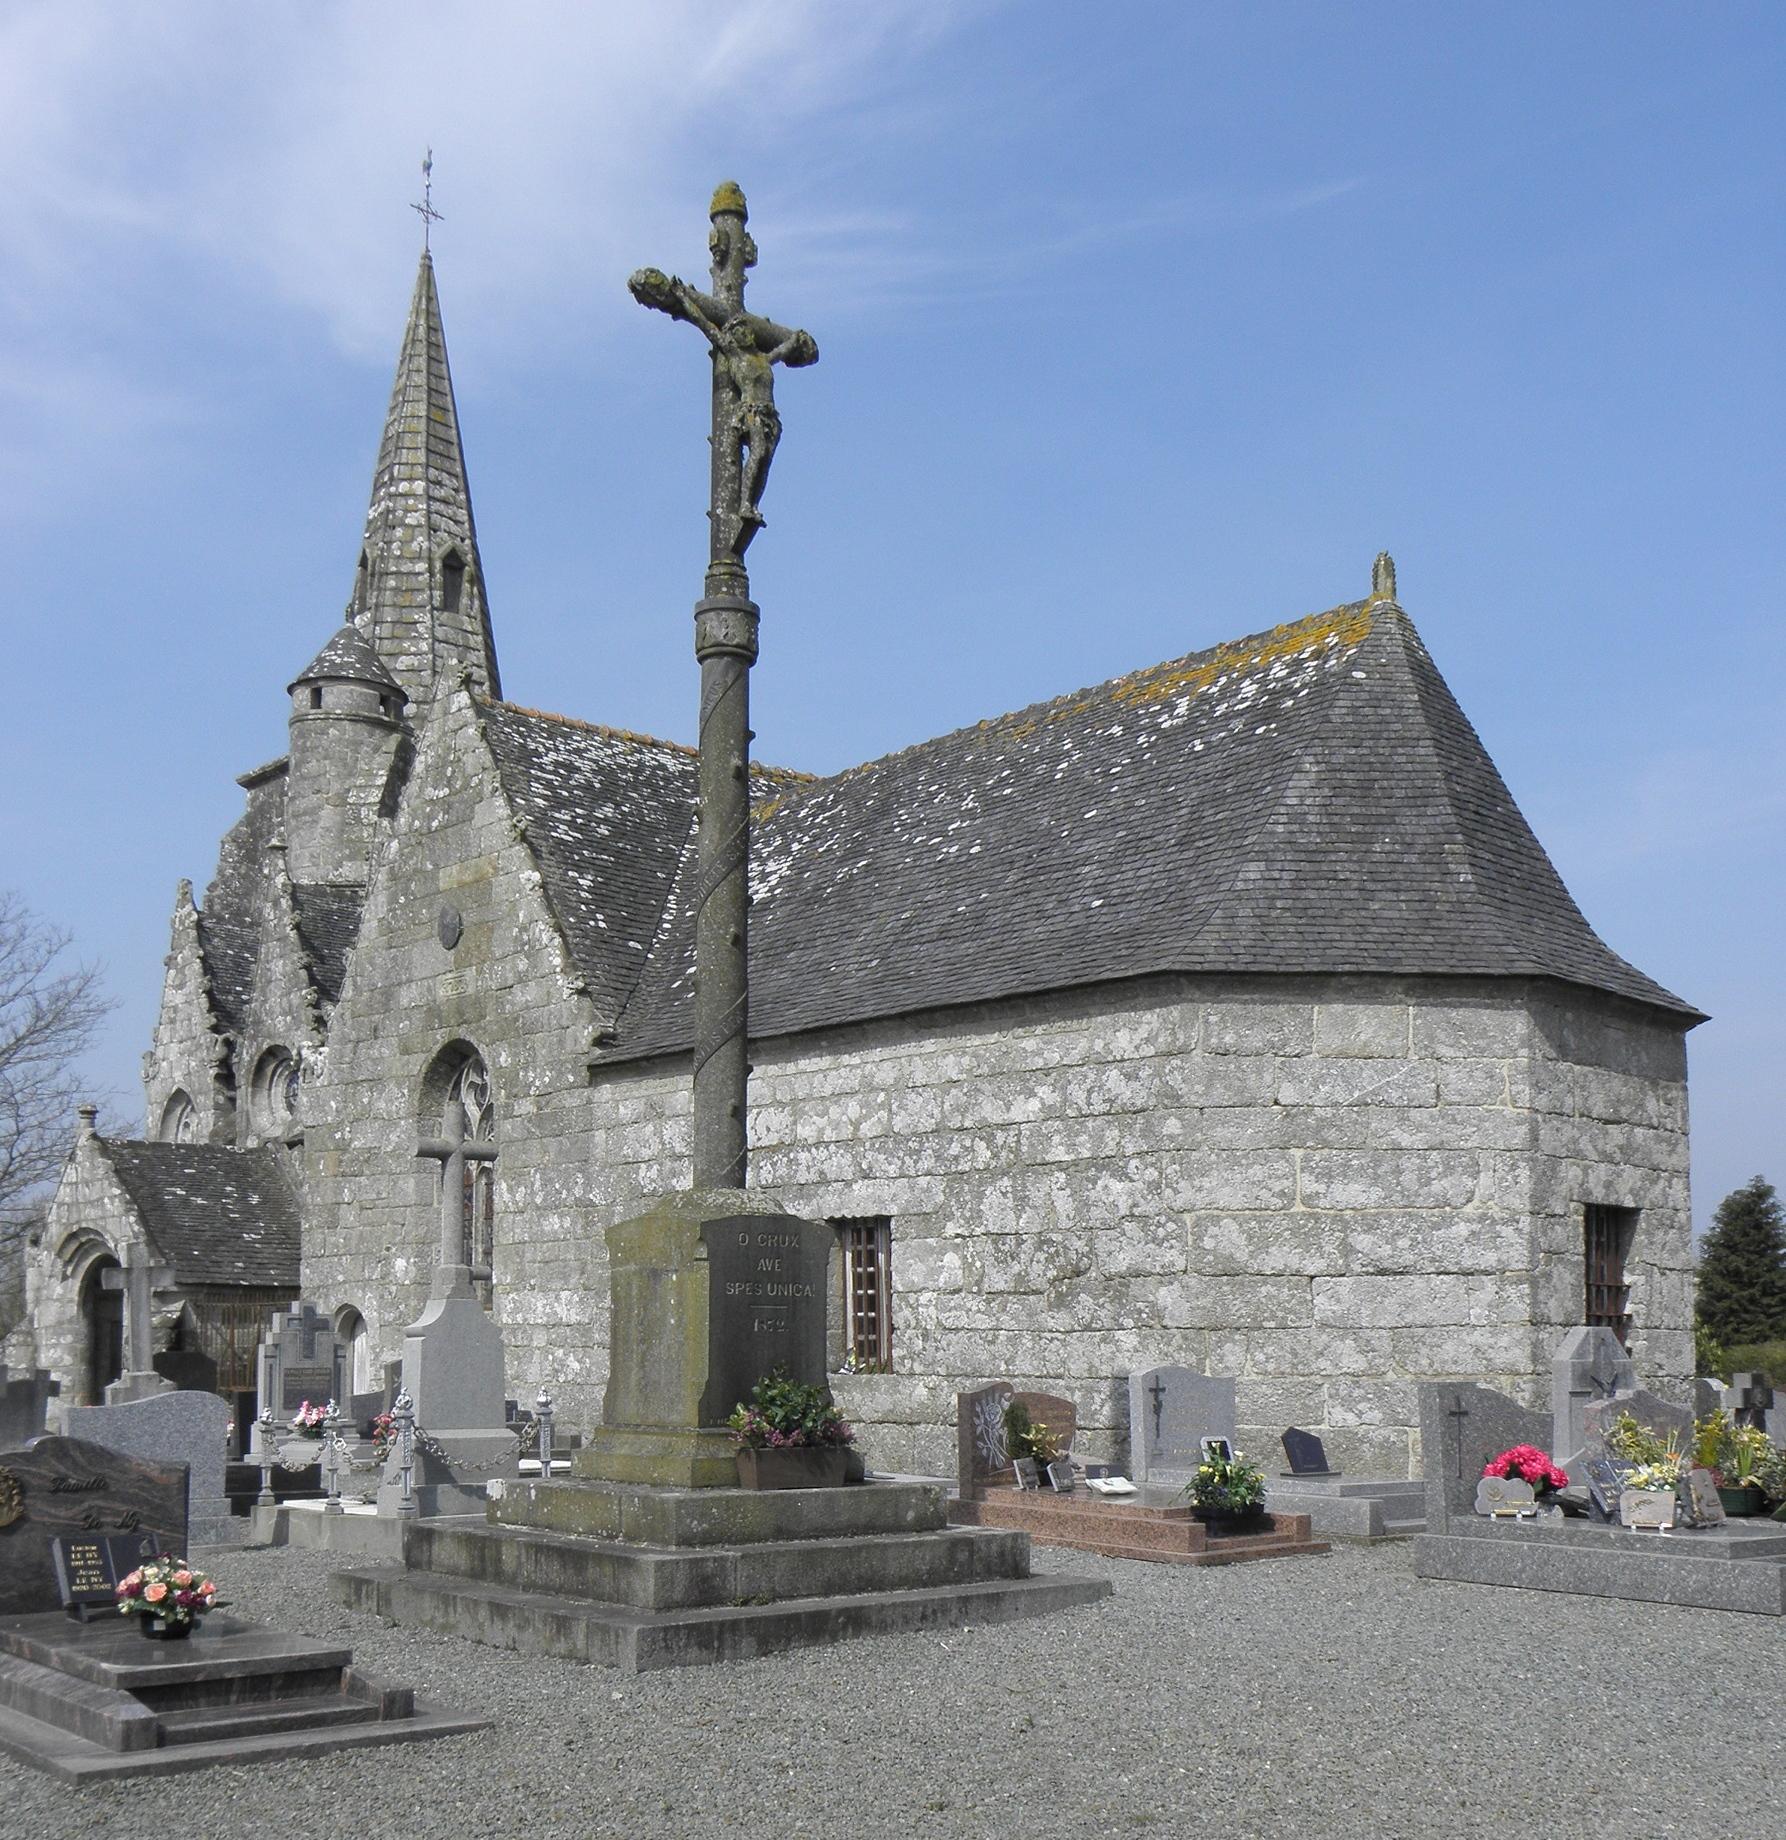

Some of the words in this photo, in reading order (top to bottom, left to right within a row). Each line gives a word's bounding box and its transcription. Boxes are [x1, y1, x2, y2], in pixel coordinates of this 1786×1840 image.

[738, 1232, 749, 1246] O
[757, 1232, 799, 1248] CRUX
[756, 1257, 782, 1271] AVE
[725, 1281, 762, 1296] SPES
